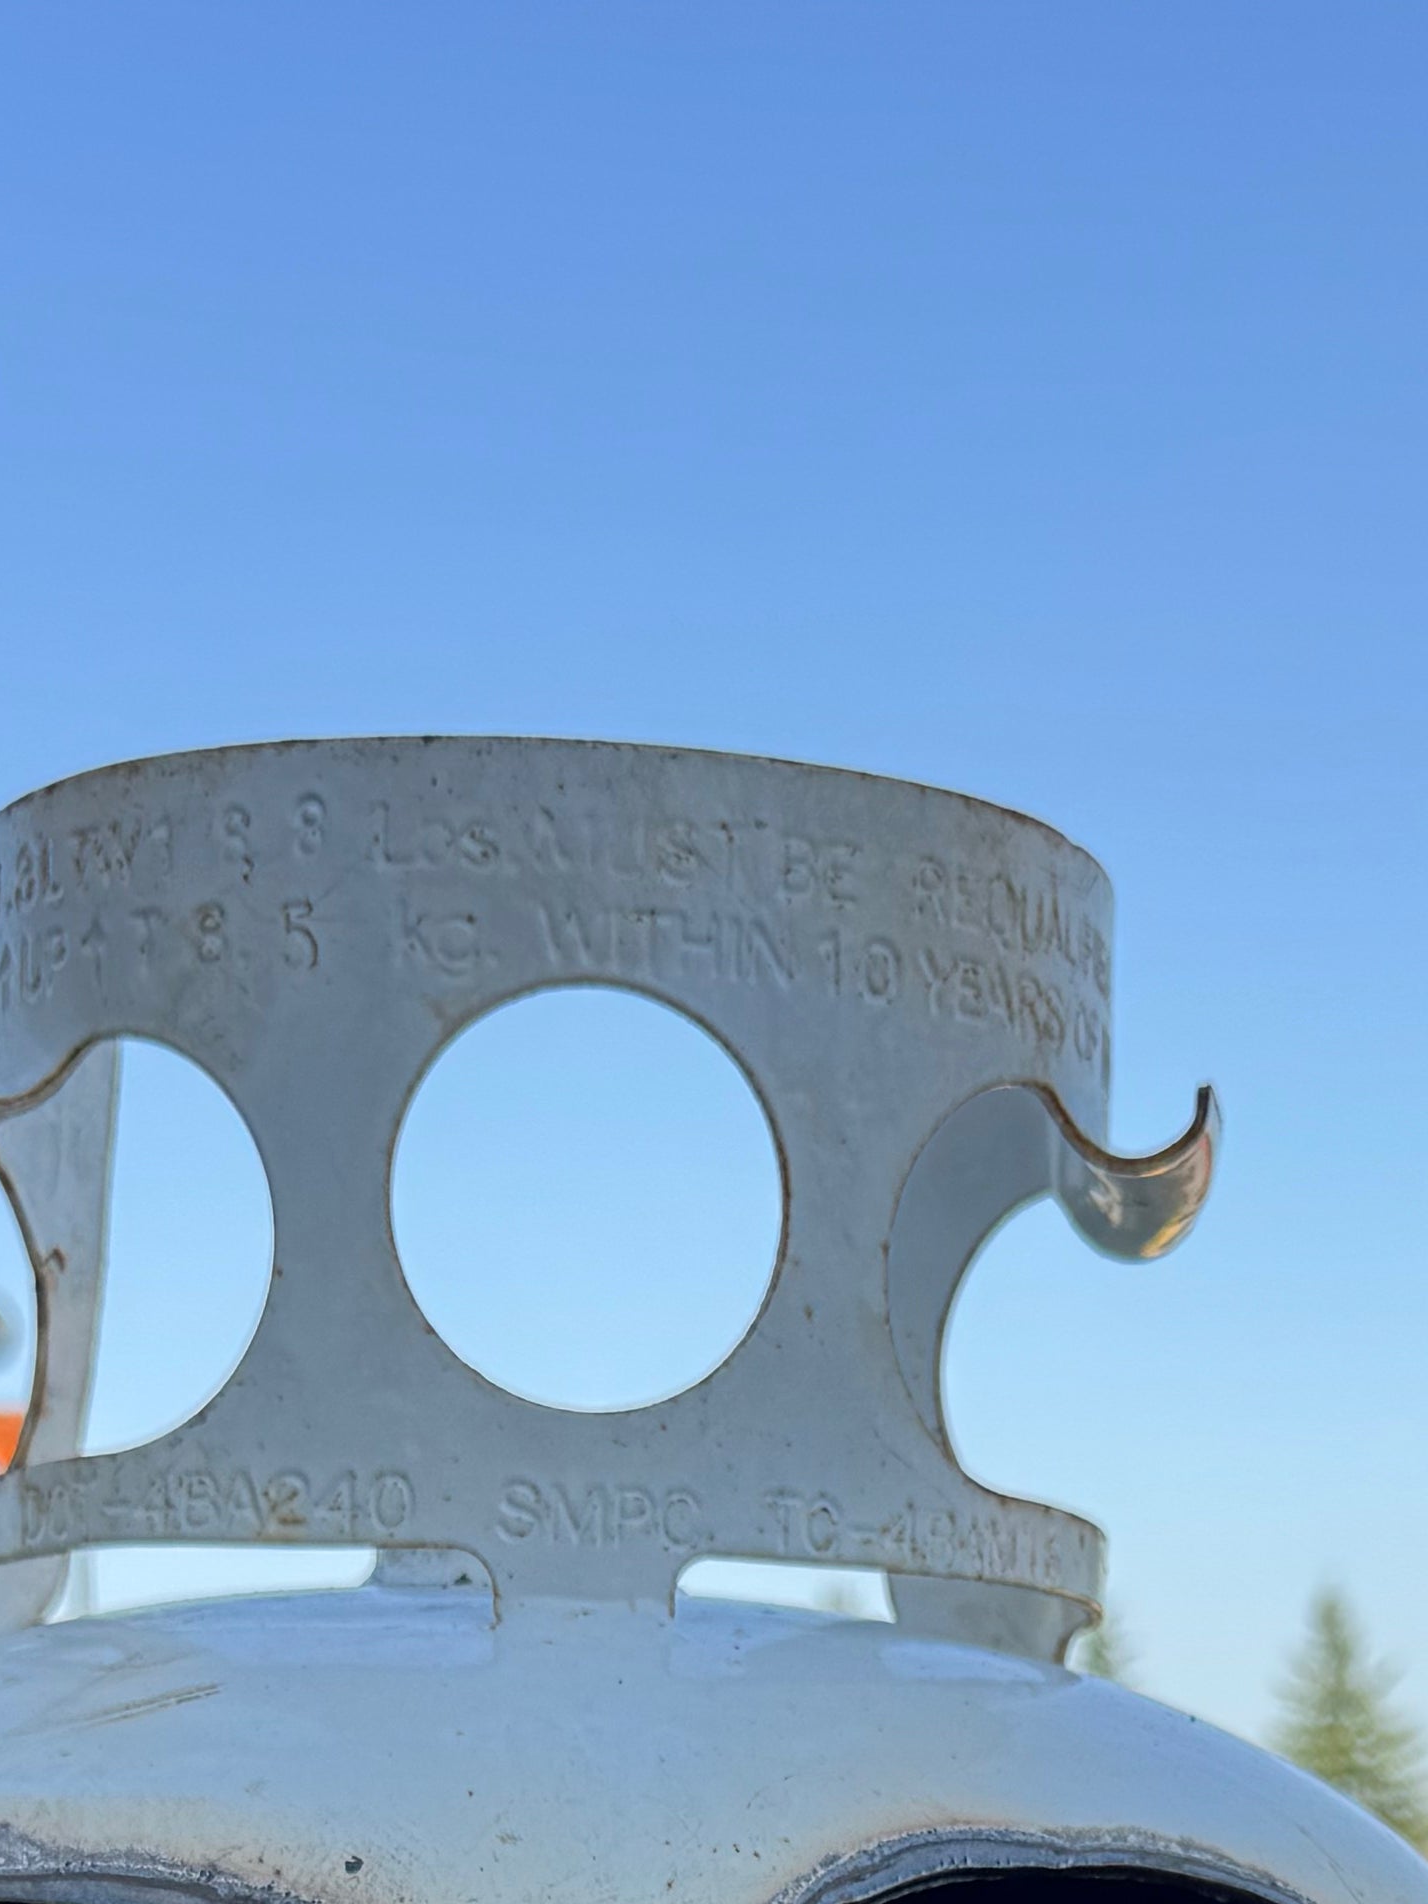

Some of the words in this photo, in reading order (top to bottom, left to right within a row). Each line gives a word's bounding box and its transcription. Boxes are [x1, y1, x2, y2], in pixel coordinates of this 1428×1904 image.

[525, 804, 768, 890] MUST
[780, 830, 866, 909] BE
[536, 902, 797, 991] WITHIN
[817, 926, 905, 1005] 10
[917, 946, 1066, 1058] YEARS
[495, 1477, 700, 1553] SMPC
